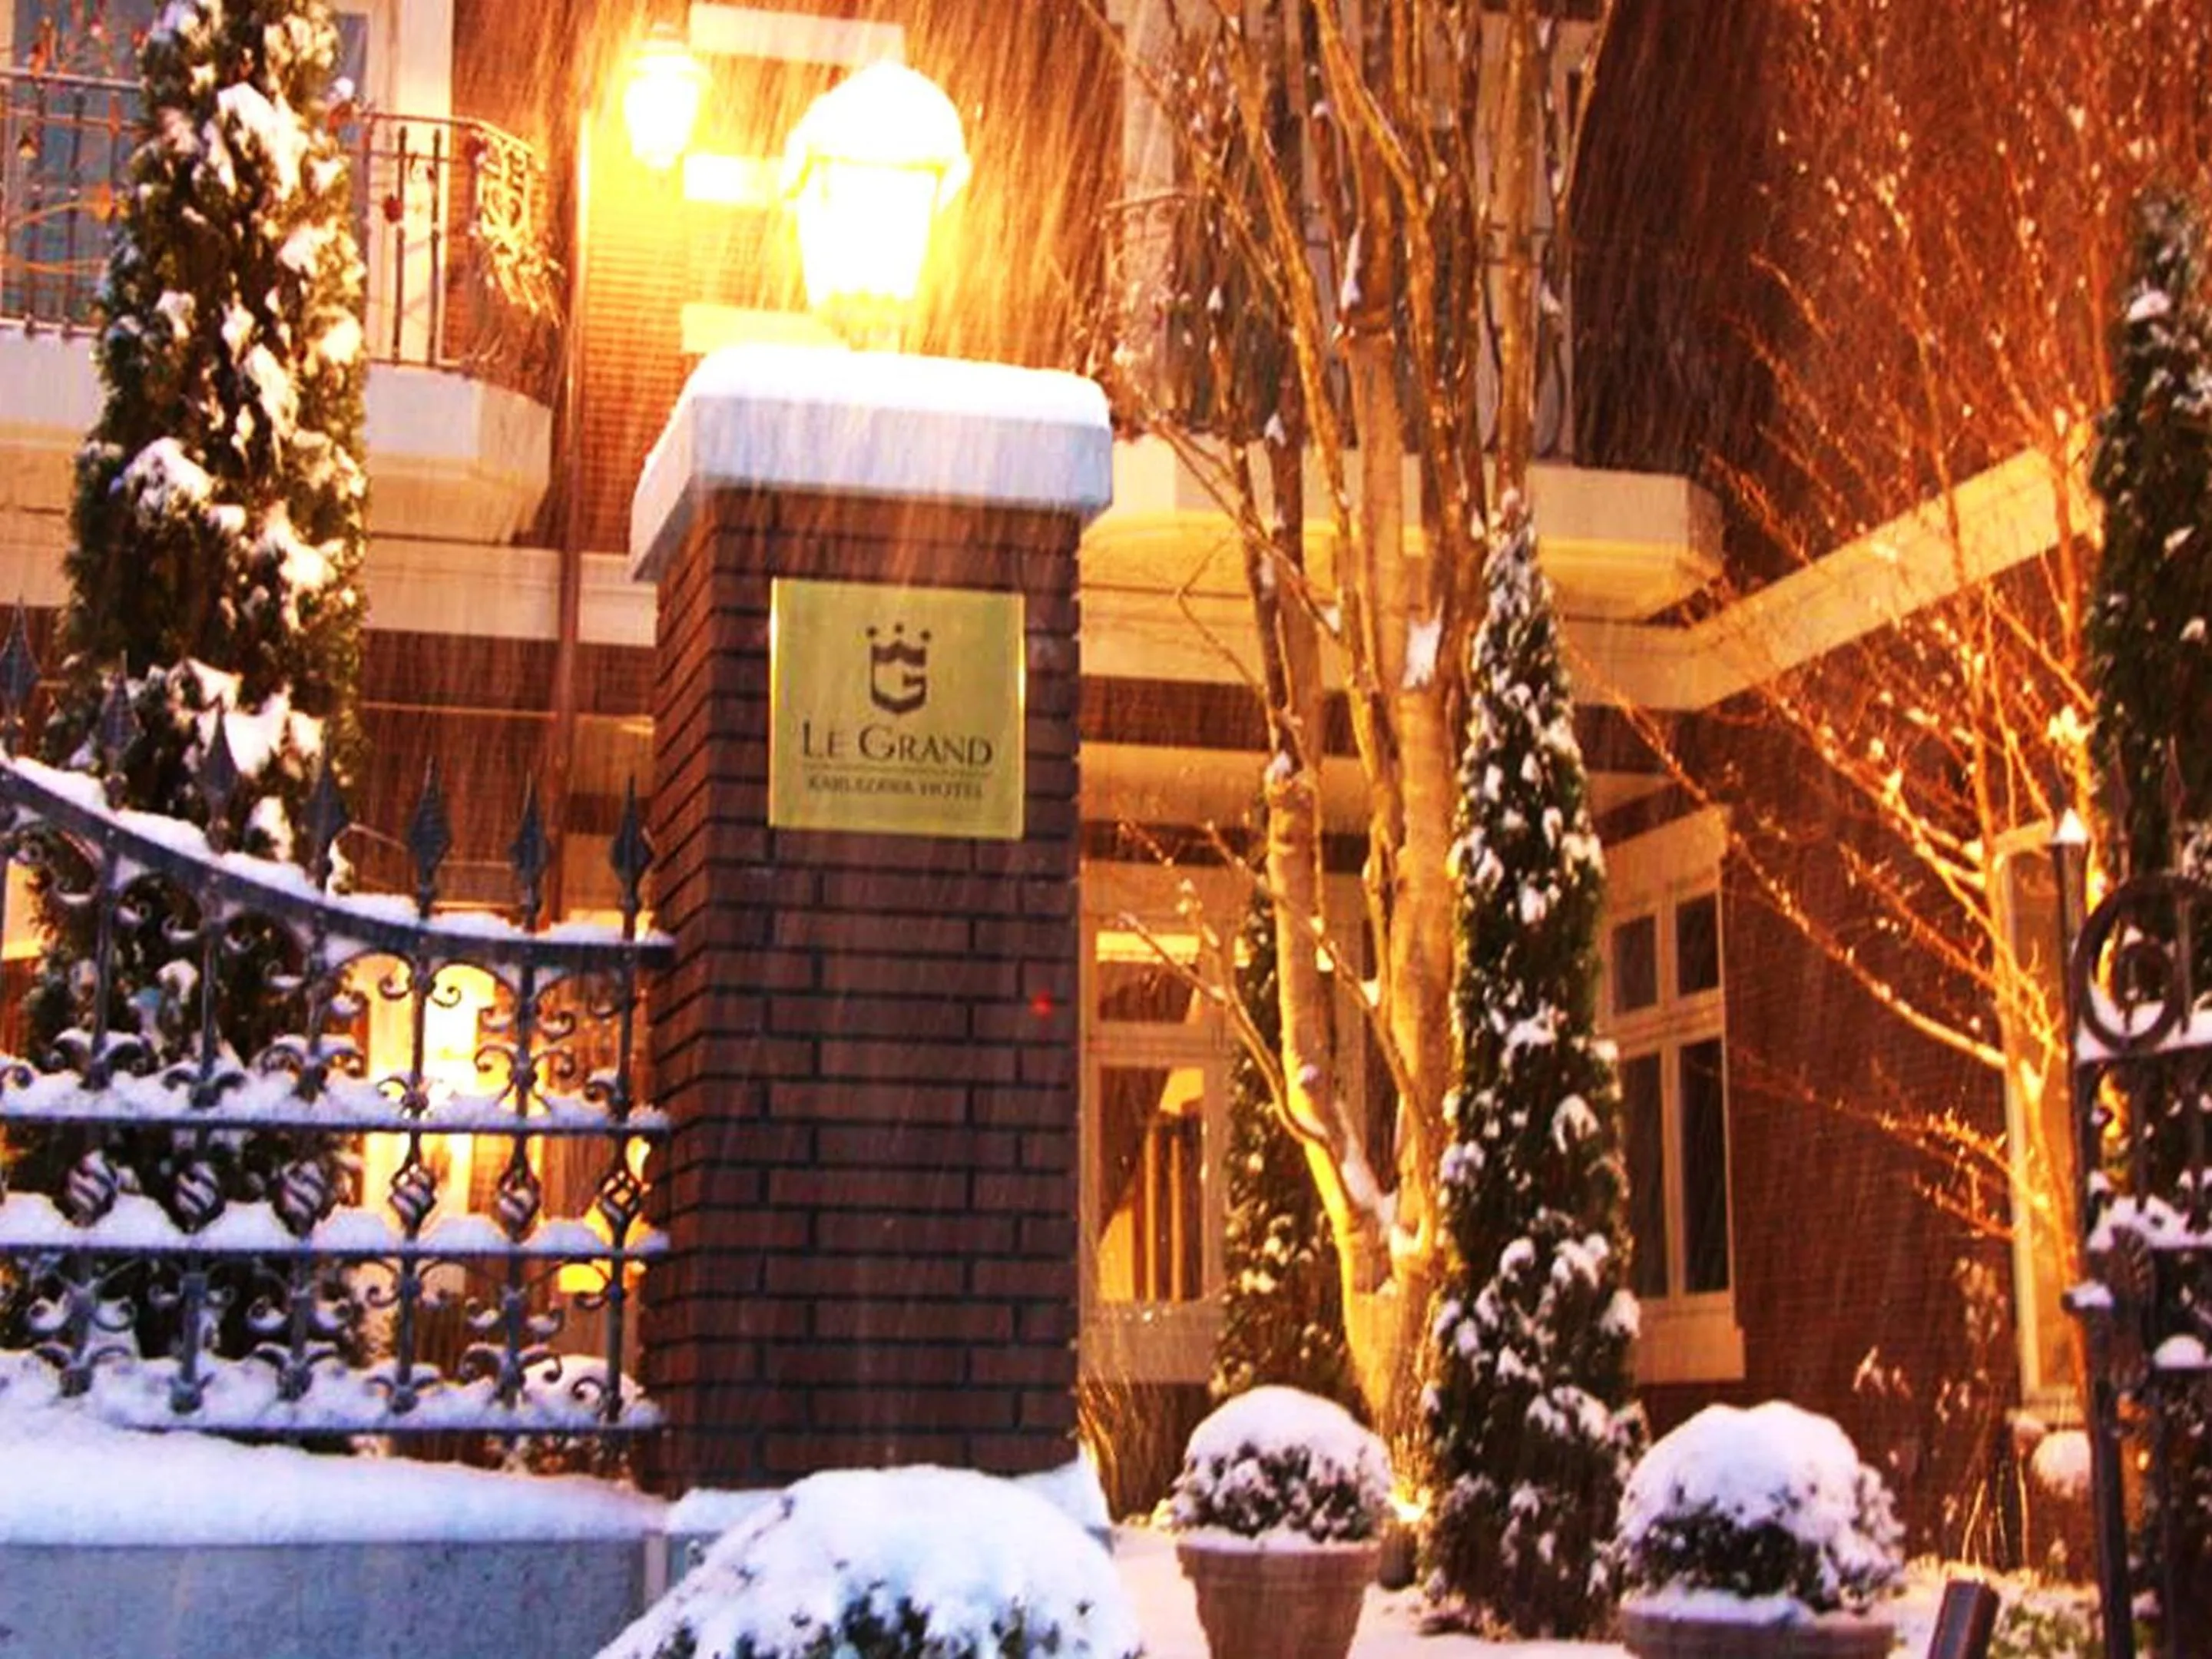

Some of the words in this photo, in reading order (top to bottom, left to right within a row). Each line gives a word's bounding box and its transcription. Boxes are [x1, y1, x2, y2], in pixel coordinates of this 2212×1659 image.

[803, 720, 843, 758] LE
[858, 723, 993, 767] GRAND
[920, 781, 982, 800] HOTEL
